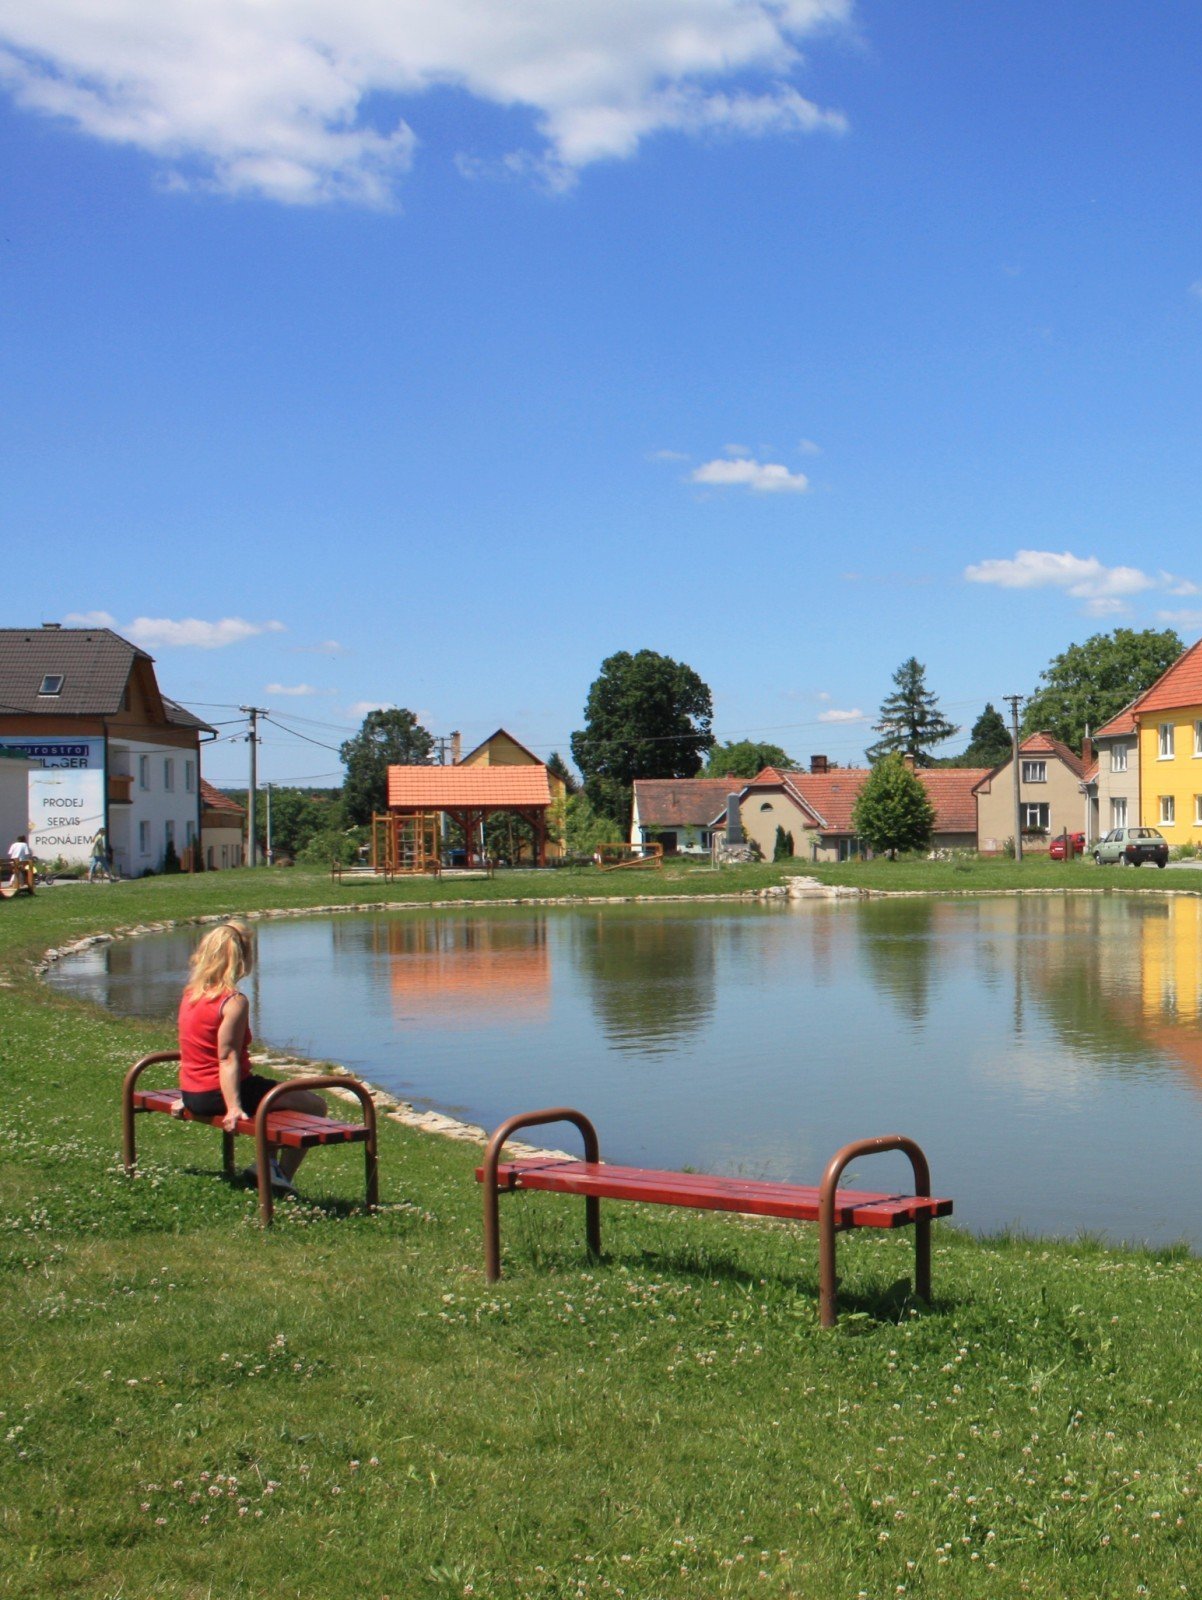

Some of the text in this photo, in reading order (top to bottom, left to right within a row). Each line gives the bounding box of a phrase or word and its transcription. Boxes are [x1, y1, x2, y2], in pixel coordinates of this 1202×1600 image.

[43, 798, 84, 808] PRODEJ
[47, 817, 81, 826] SERVIS
[35, 834, 94, 845] PRONÁJEM
